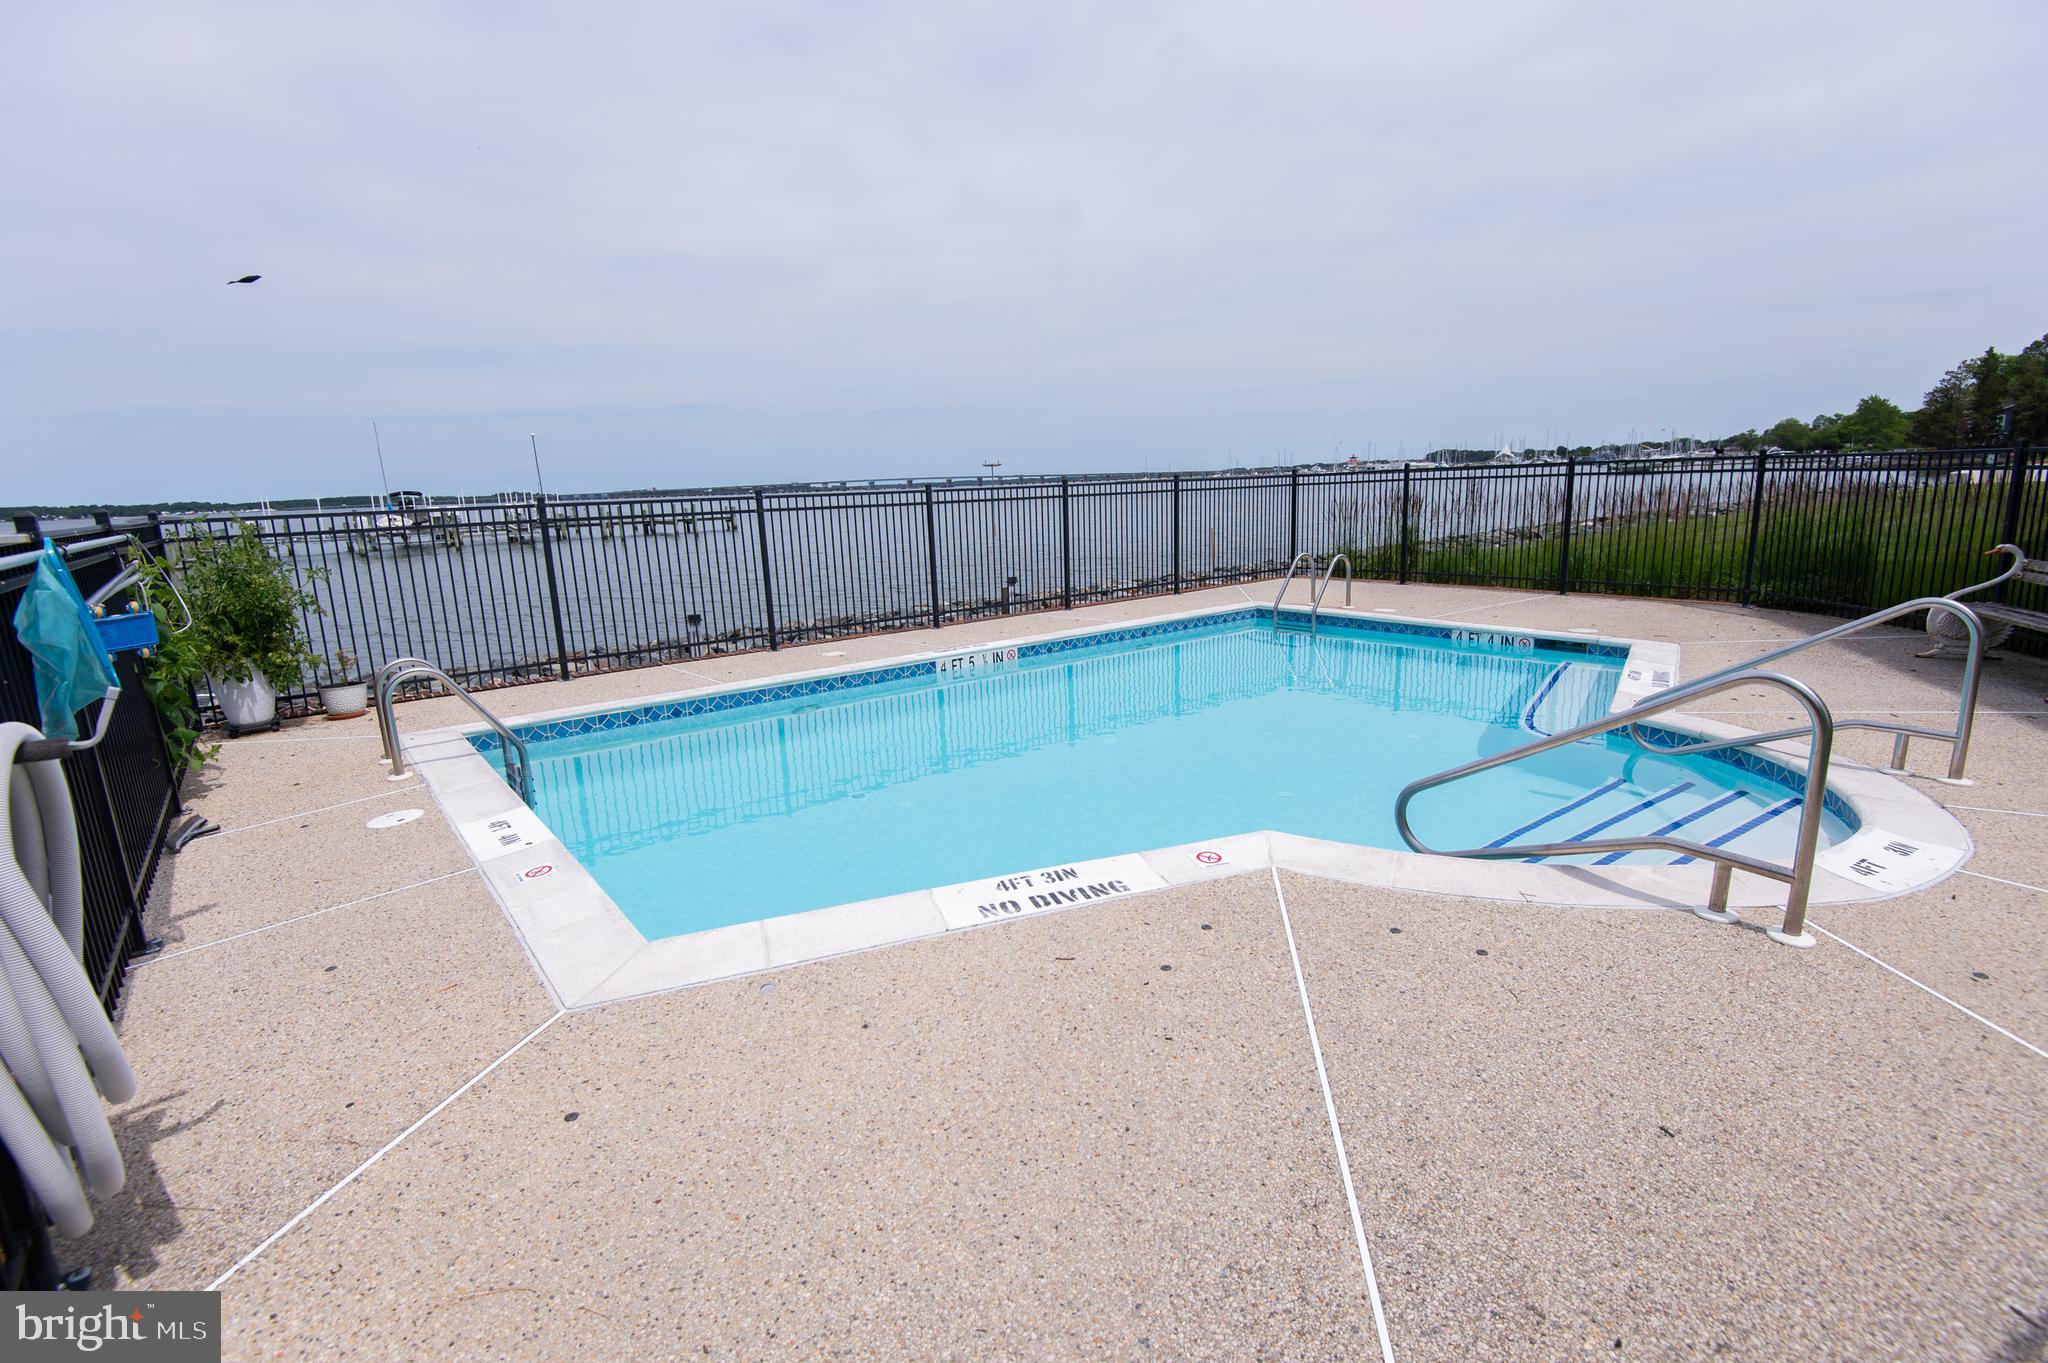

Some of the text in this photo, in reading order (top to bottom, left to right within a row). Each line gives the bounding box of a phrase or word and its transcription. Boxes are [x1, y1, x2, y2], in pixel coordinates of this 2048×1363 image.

[1468, 632, 1481, 642] FT
[1501, 636, 1515, 646] IN
[940, 661, 947, 671] 4
[952, 657, 963, 670] FT
[969, 656, 975, 667] 5
[992, 651, 1003, 663] IN
[1849, 840, 1920, 876] 4FT 3IN
[996, 866, 1079, 892] 4FT 3IN
[977, 879, 1132, 919] NO DIVING
